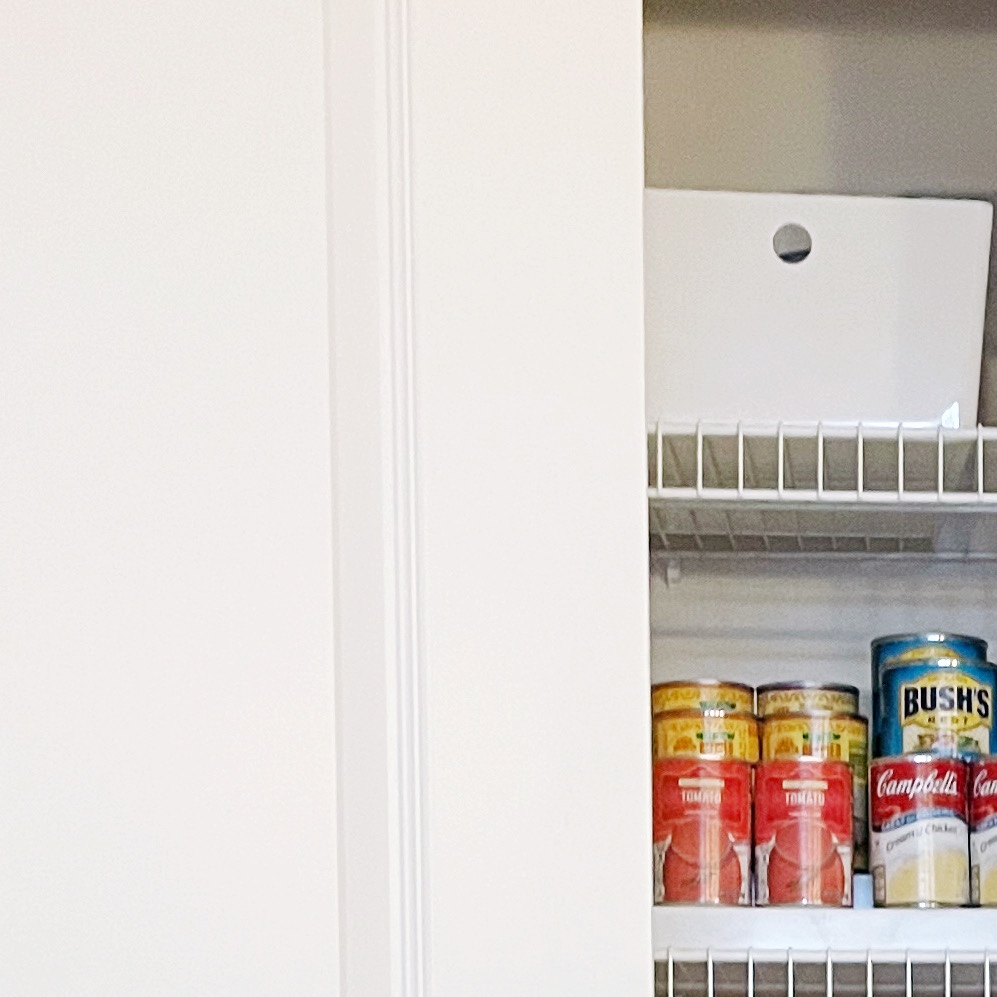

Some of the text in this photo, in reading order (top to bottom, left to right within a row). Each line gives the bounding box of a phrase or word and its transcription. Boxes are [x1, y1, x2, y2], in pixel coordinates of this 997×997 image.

[904, 686, 989, 719] BUSH'S
[681, 789, 722, 805] TOMATO
[785, 791, 826, 806] TOMATO
